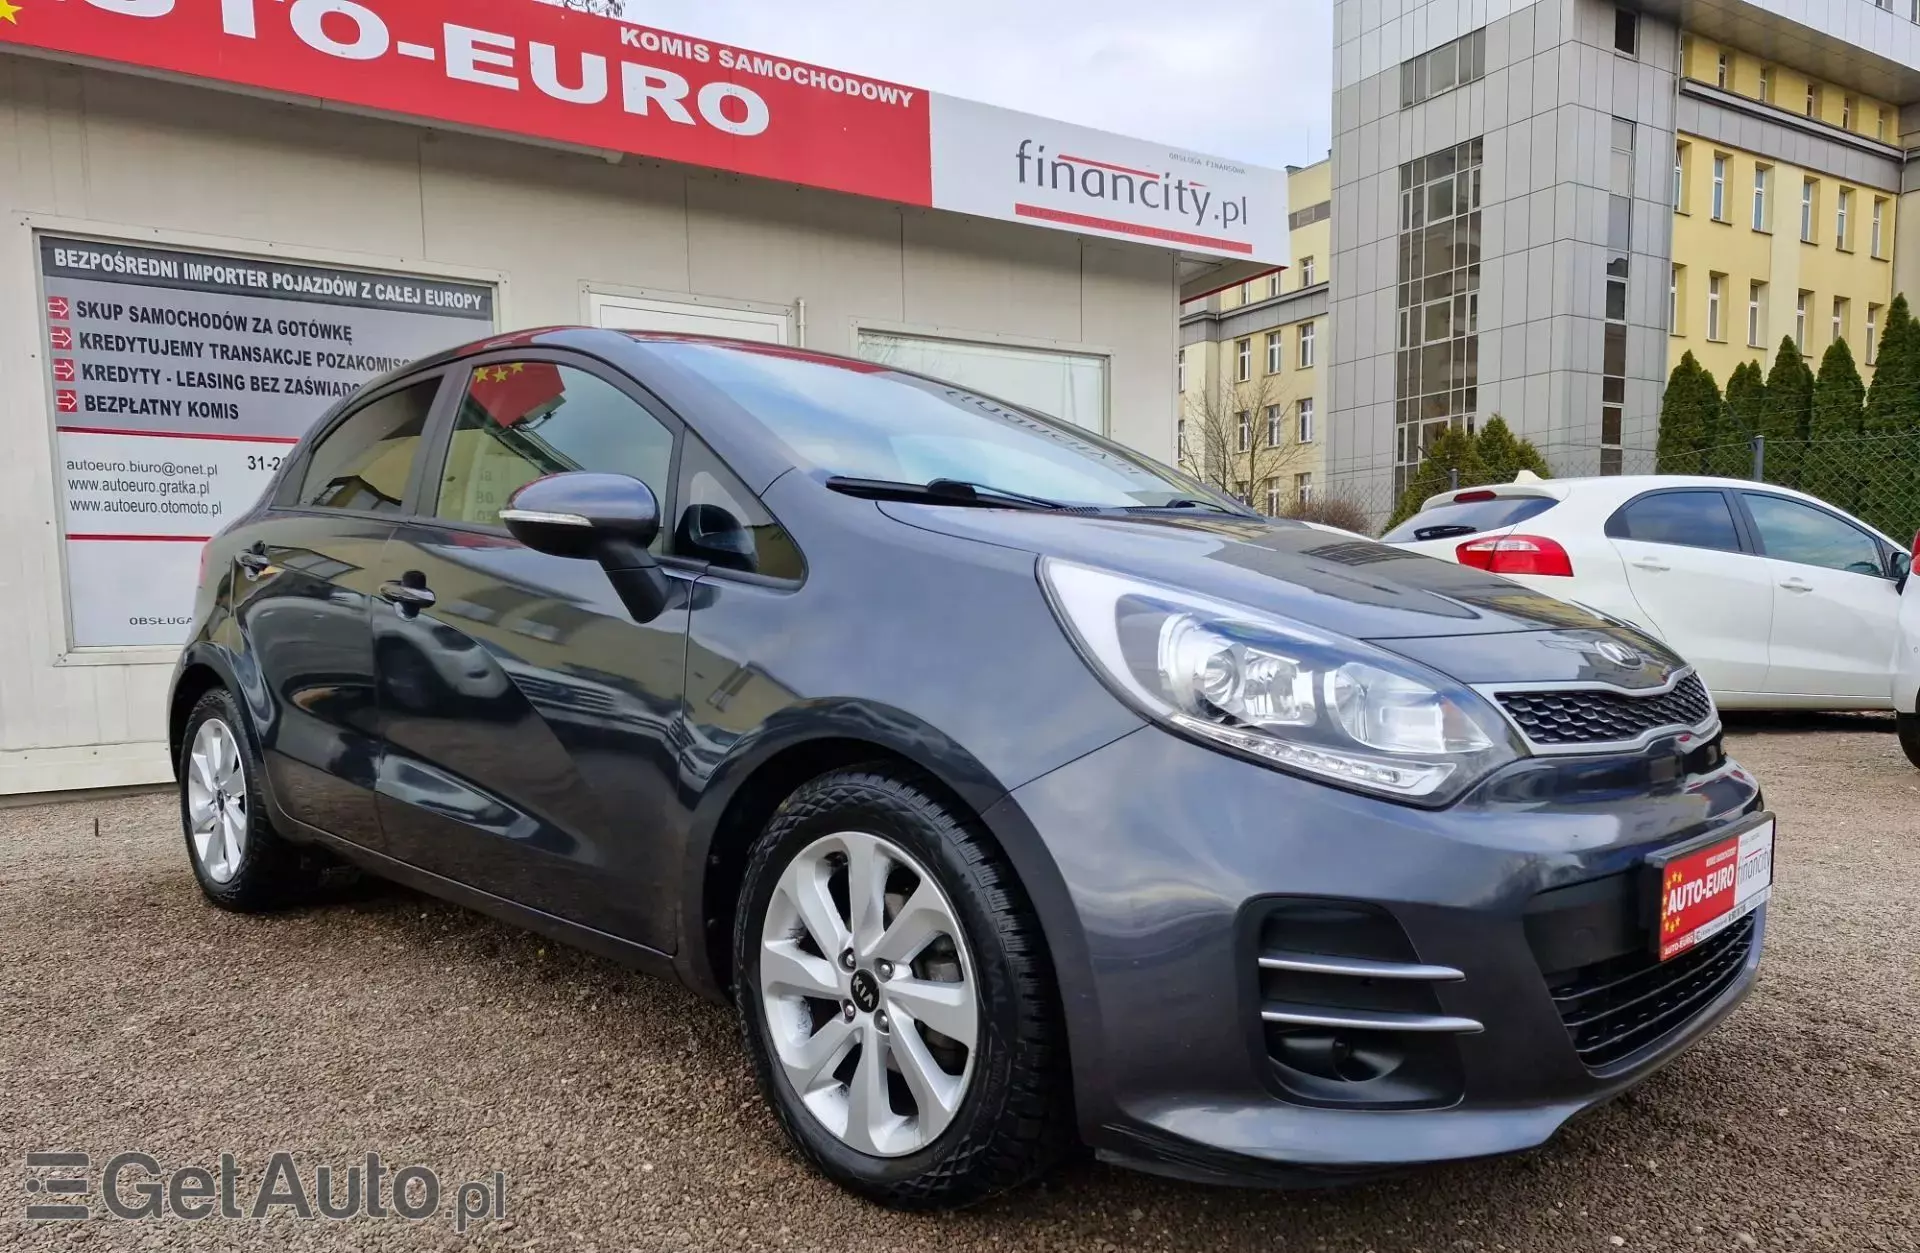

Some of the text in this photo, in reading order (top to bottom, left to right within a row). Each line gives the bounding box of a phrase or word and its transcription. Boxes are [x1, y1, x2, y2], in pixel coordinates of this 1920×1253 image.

[620, 26, 913, 109] KOMIS SAMOCHODOWY
[1016, 139, 1247, 228] financity.pl
[54, 248, 482, 311] BEZPOŚREDNI IMPORTER POJAZDÓW Z CAŁEJ EUROPY
[76, 300, 353, 346] SKUP SAMOCHODÓW ZA GOTÓWKĘ
[79, 332, 204, 358] KREDYTUJEMY
[209, 343, 311, 368] TRANSAKCJE
[82, 363, 161, 386] KREDYTY
[176, 370, 245, 391] LEASING
[250, 374, 280, 394] BEZ
[84, 394, 239, 420] BEZPŁATNY KOMIS
[66, 460, 218, 477] autoeuro.biuro@onet.pl
[247, 455, 287, 471] 31-2
[68, 477, 210, 496] www.autoeuro.gratka.pl
[70, 499, 222, 517] www.autoeuro.otomoto.pl
[1667, 863, 1735, 916] AUTO-EURO
[853, 975, 873, 1008] KIA
